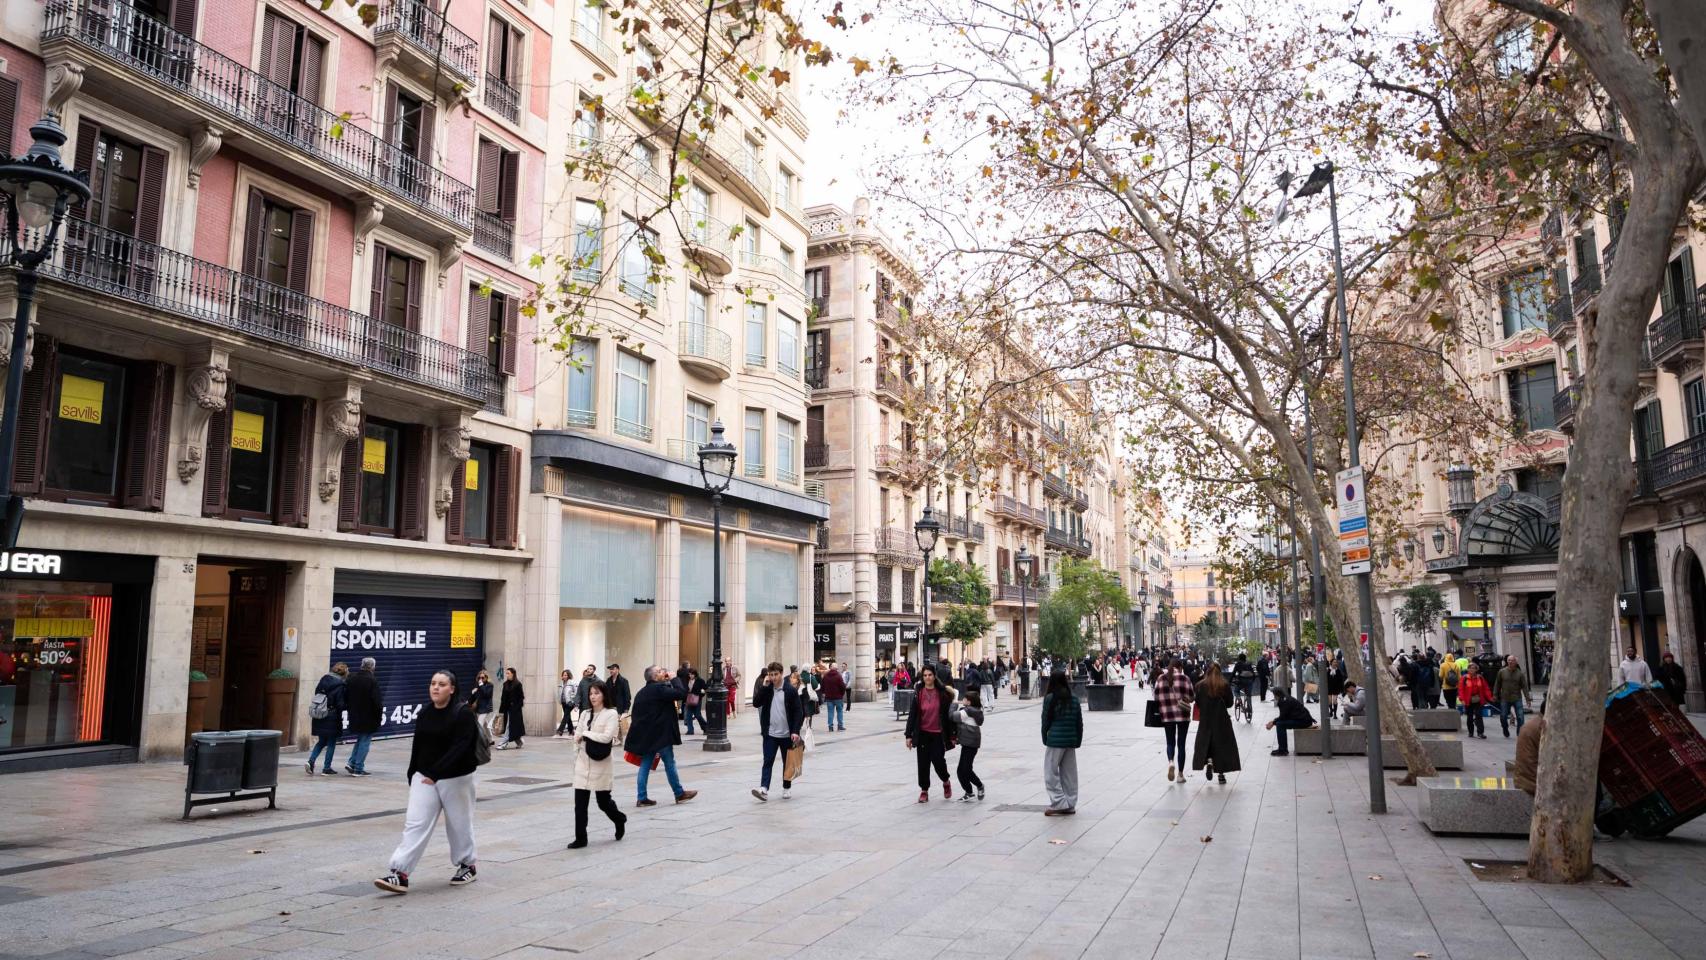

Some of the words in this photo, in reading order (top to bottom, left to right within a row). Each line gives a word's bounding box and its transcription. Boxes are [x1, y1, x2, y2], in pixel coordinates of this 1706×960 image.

[61, 404, 100, 422] savills
[232, 436, 261, 450] savills
[331, 606, 382, 627] OCAL
[331, 630, 427, 649] ISPONIBLE
[452, 634, 475, 646] savills
[878, 633, 894, 642] PRATS
[903, 631, 917, 639] PRATS
